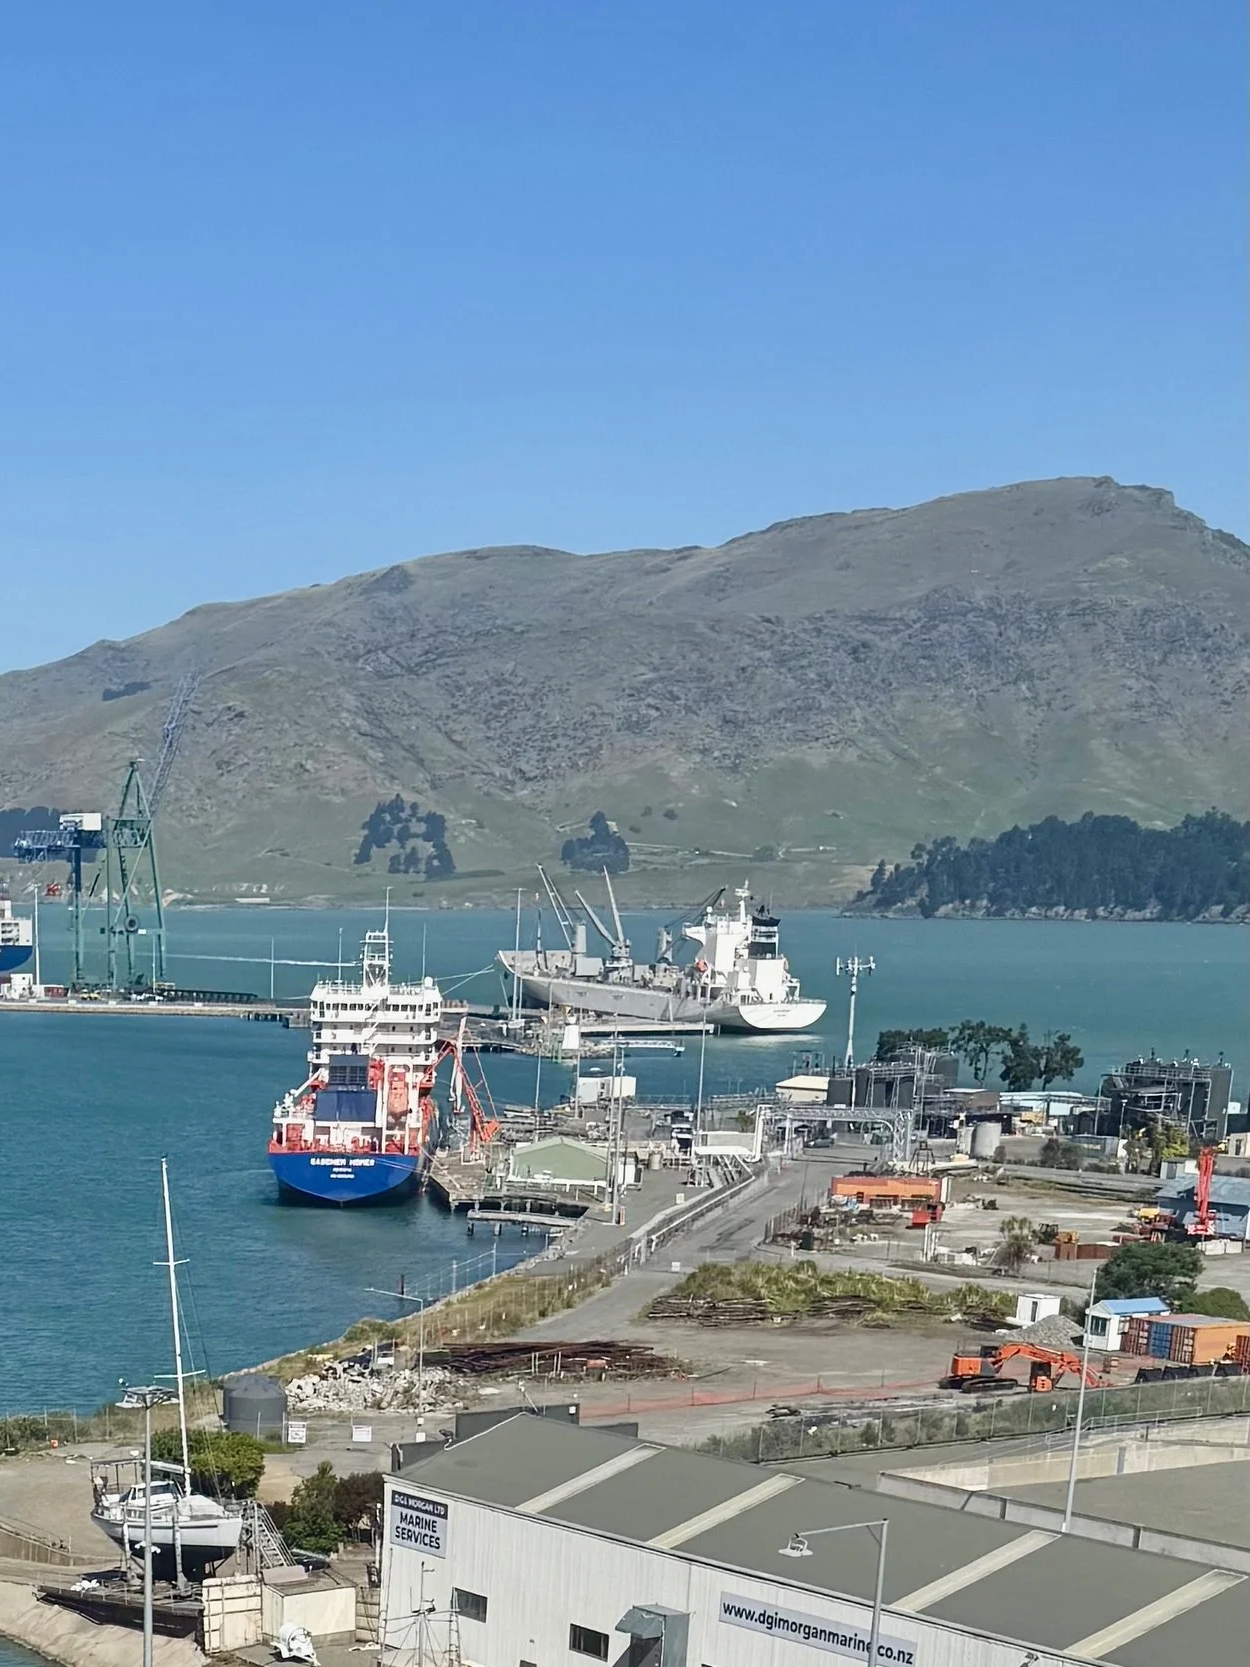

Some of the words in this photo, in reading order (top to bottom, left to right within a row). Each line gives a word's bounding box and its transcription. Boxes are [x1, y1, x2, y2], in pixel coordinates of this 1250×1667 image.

[399, 1511, 438, 1534] MARINE
[395, 1525, 441, 1550] SERVICES
[722, 1602, 914, 1665] www.dgimorganmarineco.nz
